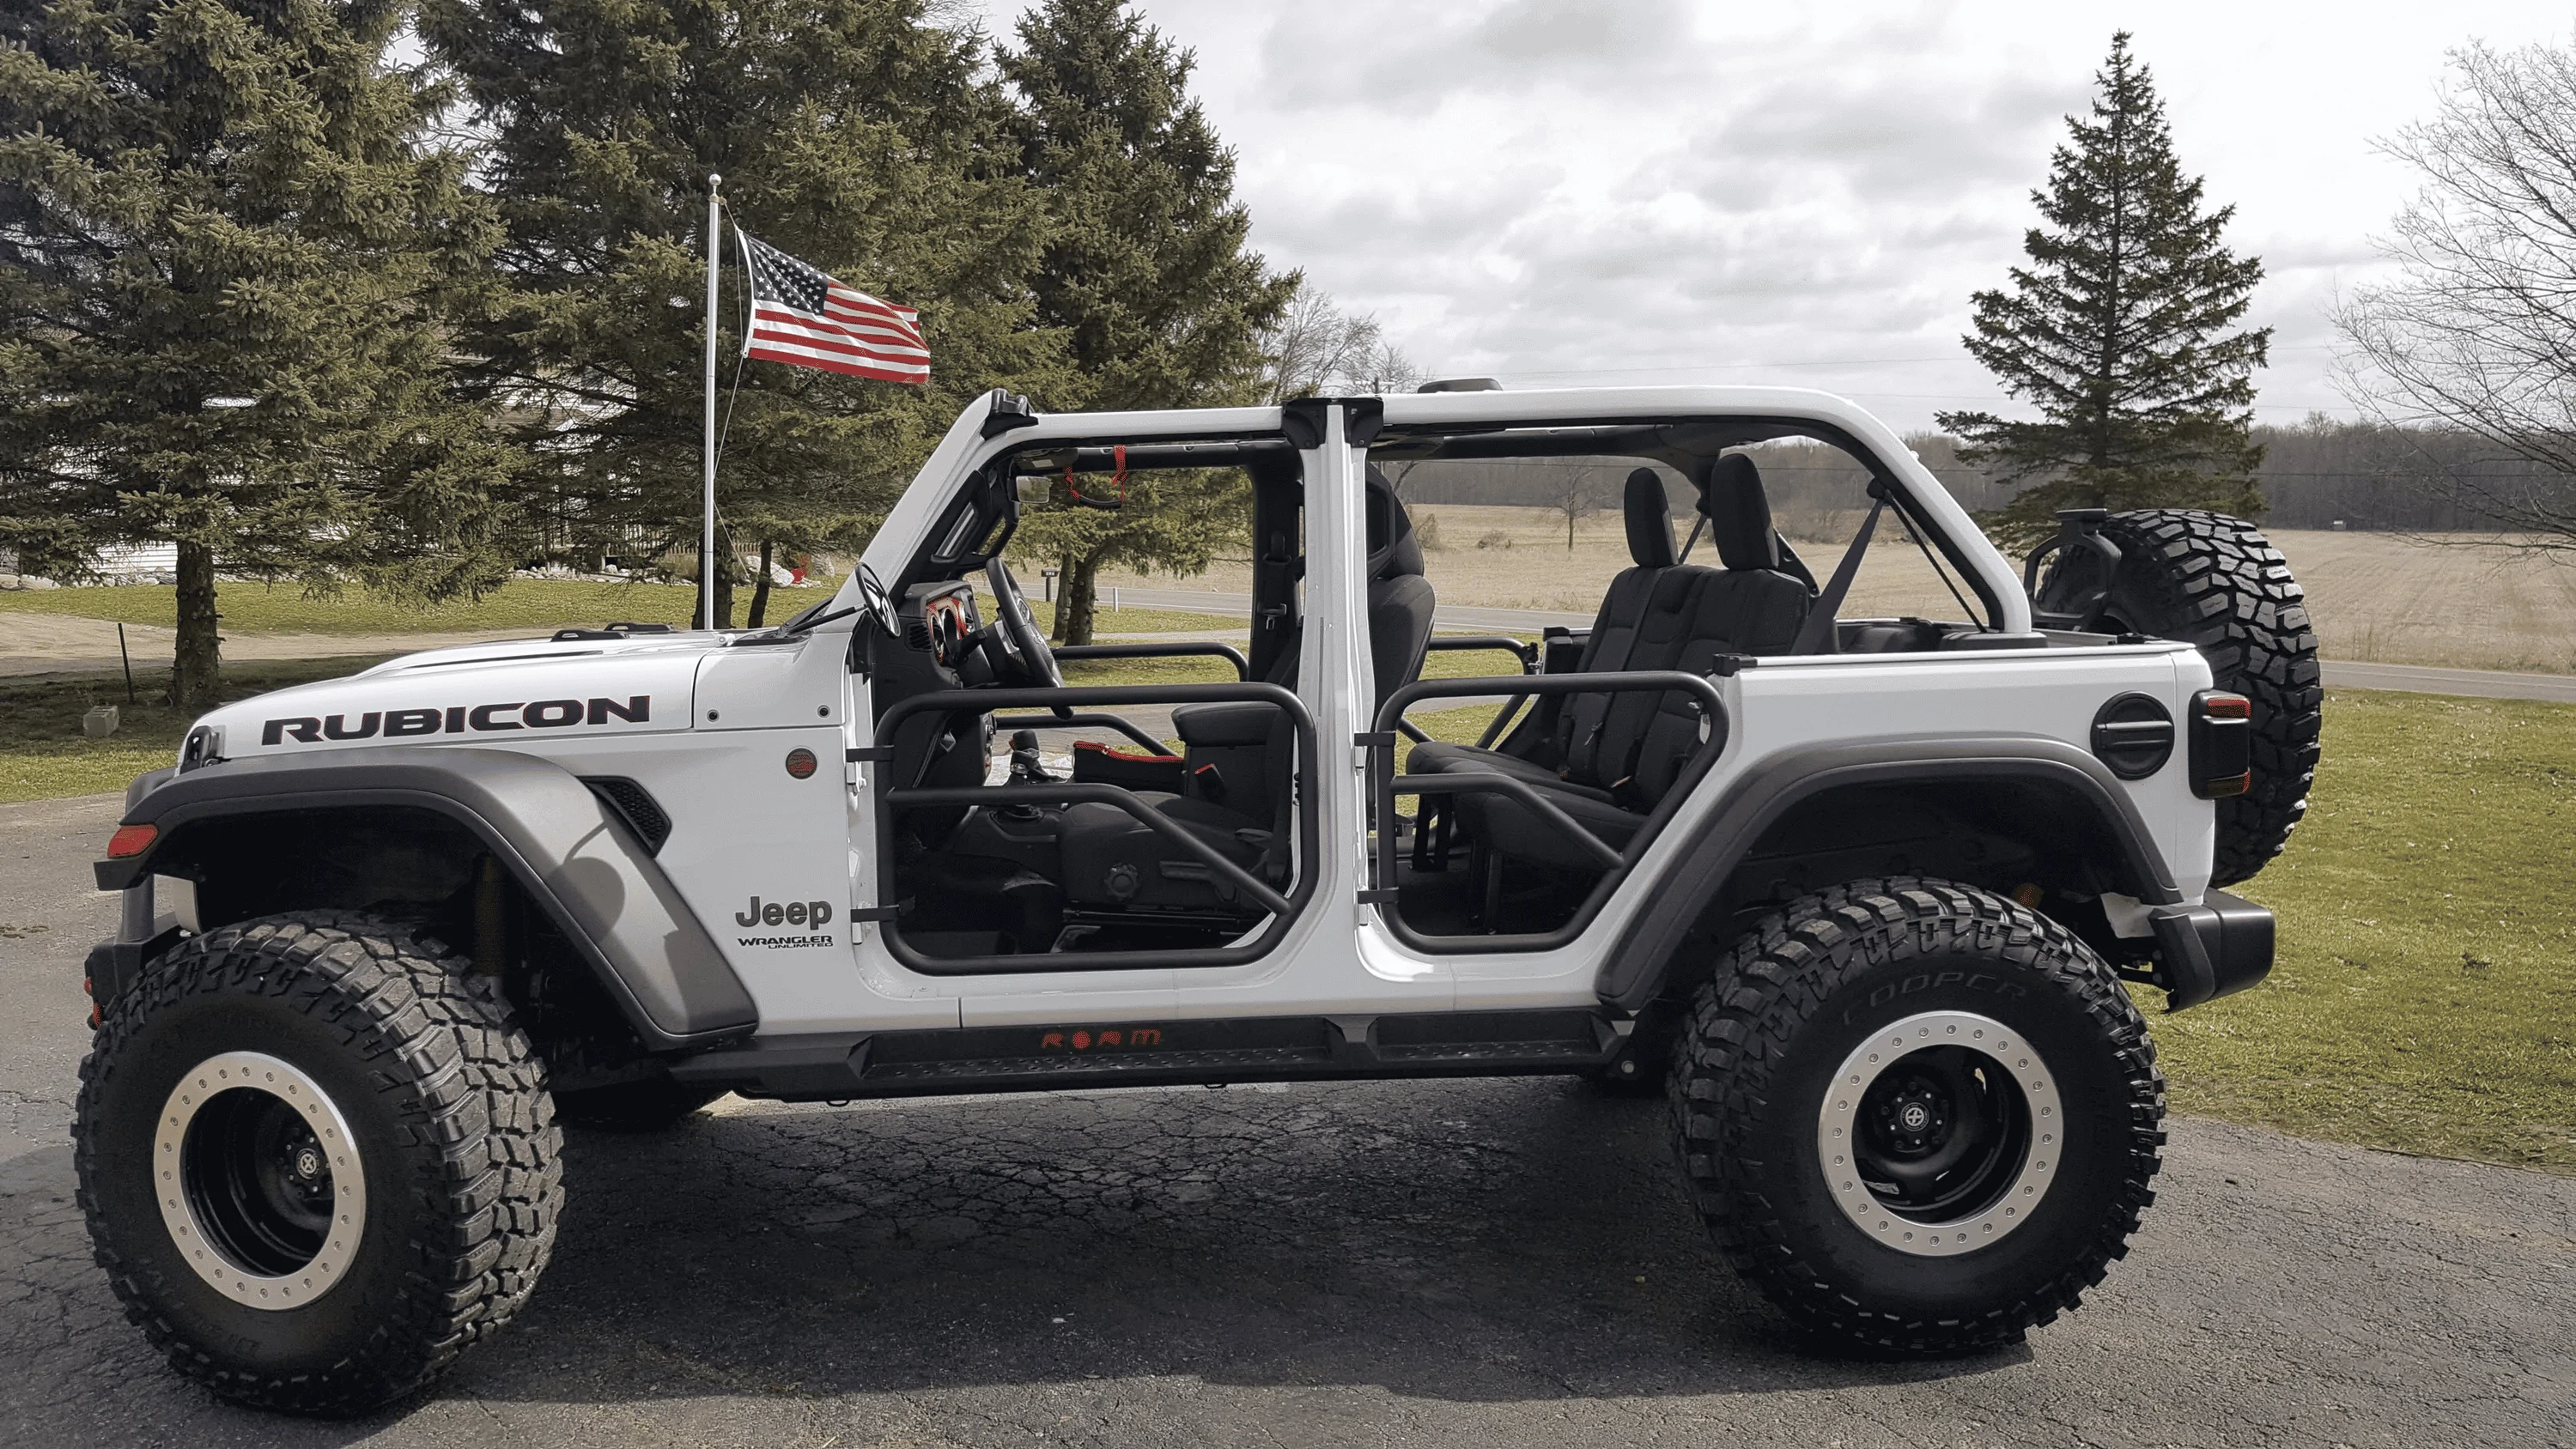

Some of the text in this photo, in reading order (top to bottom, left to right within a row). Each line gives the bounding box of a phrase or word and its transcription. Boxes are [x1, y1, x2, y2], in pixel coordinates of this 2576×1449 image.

[261, 695, 651, 746] RUBICON
[735, 896, 833, 931] Jeep
[738, 936, 833, 946] WRANGLER
